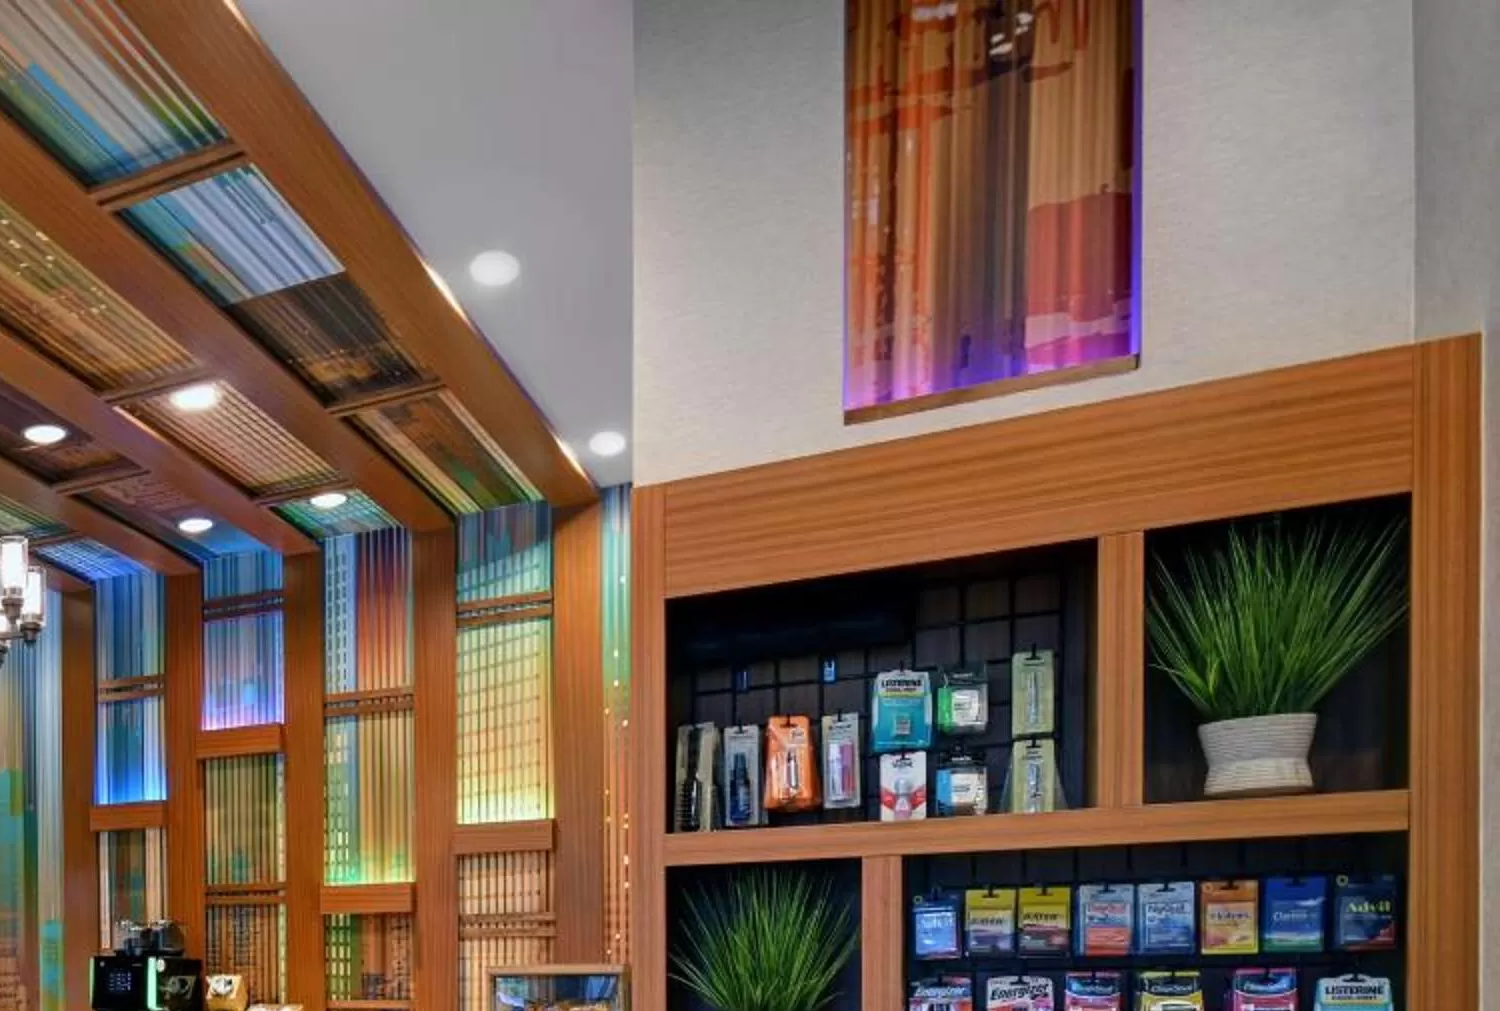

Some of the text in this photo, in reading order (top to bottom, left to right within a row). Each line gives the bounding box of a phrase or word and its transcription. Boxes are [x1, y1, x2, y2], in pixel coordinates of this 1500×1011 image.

[1347, 900, 1391, 912] Advil
[916, 985, 963, 998] Energizer
[990, 983, 1049, 1001] Energizer
[1325, 985, 1384, 995] LISTERINE
